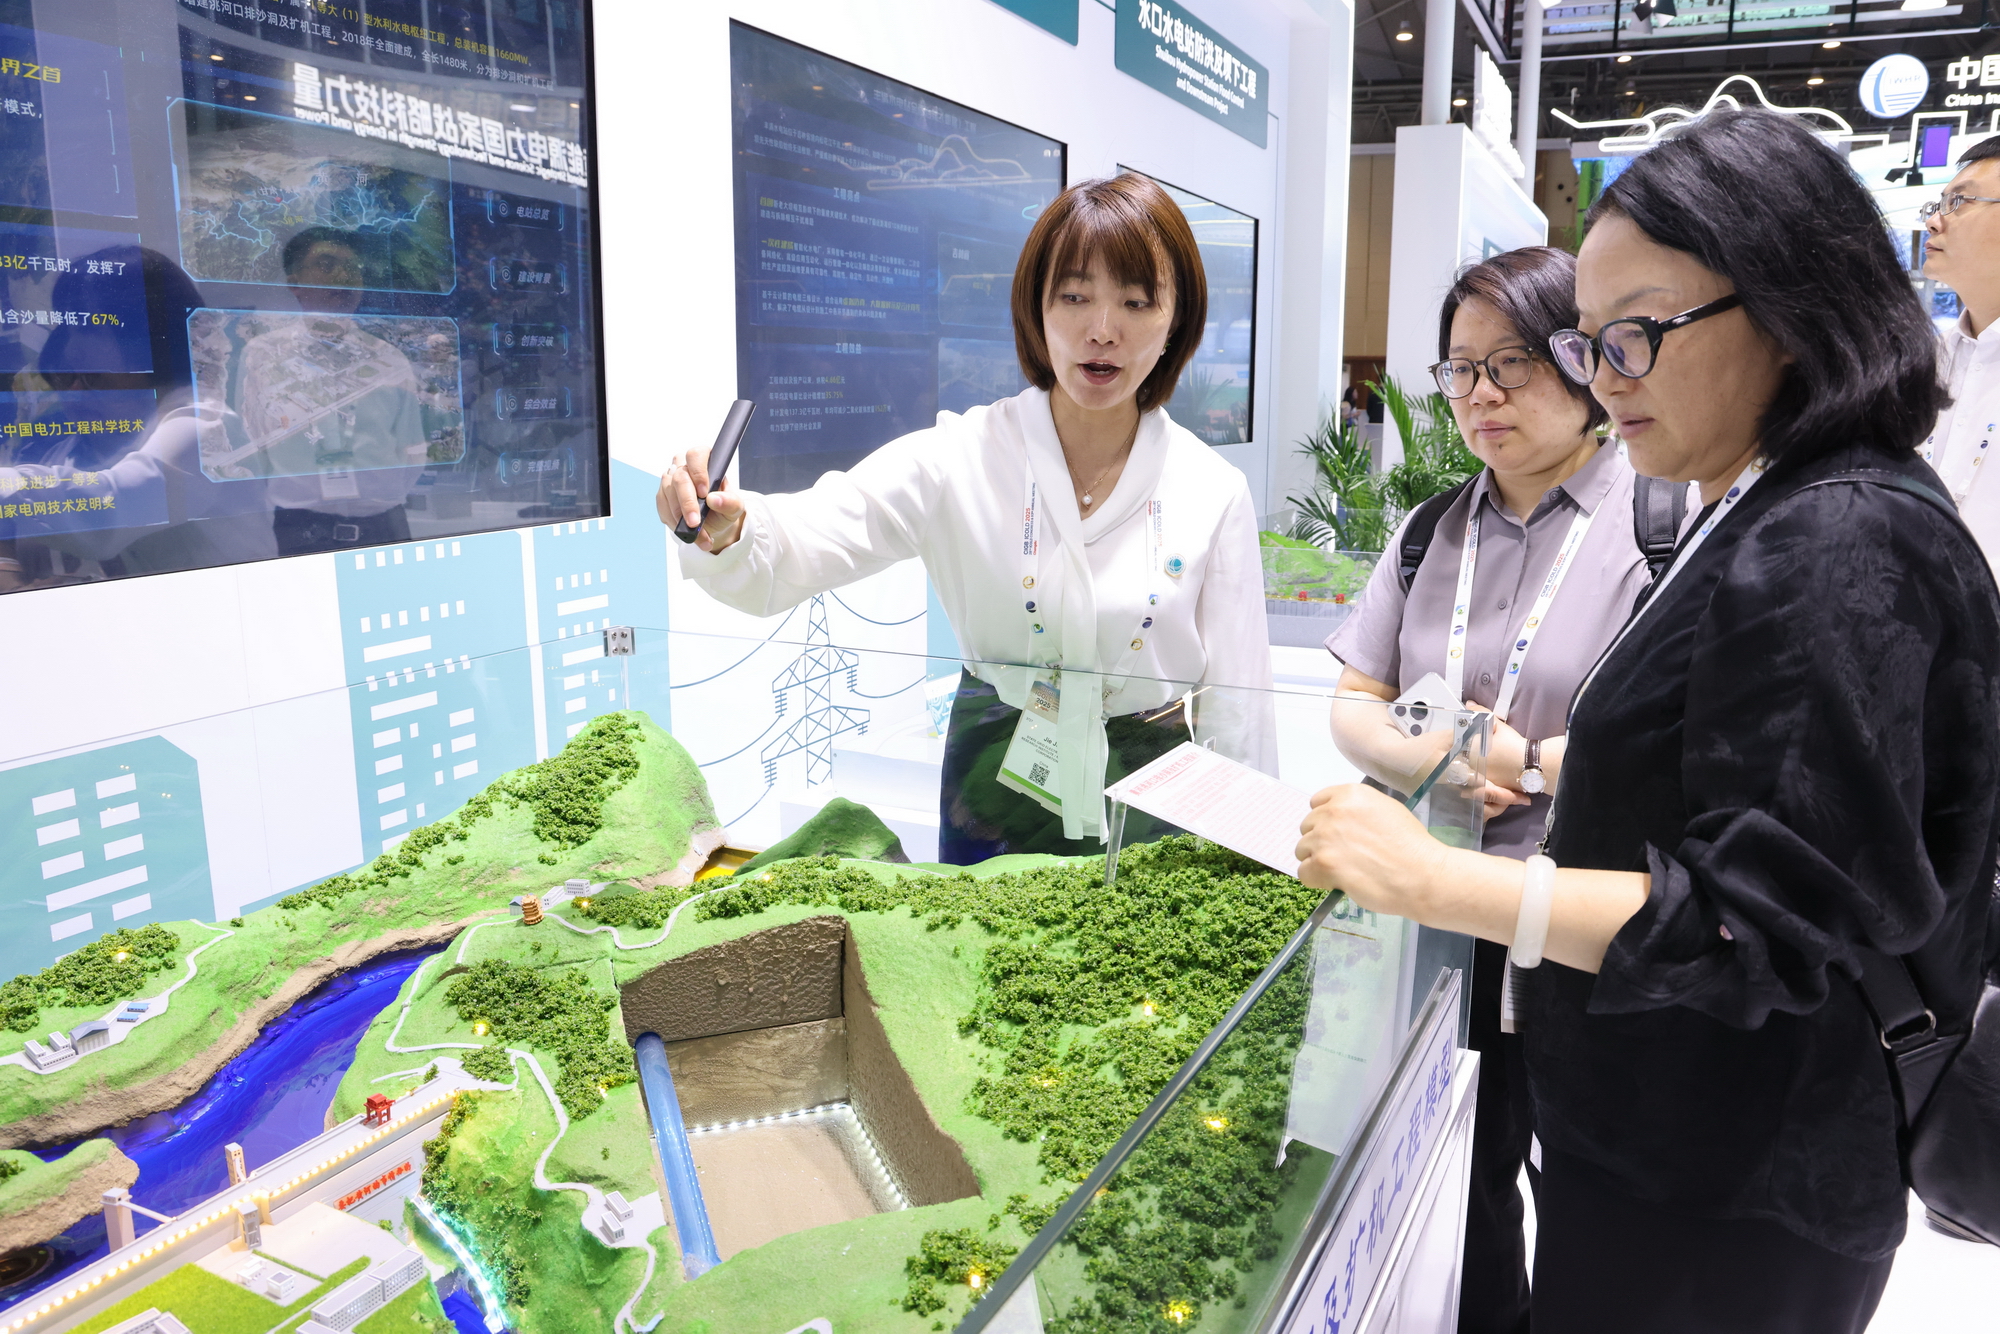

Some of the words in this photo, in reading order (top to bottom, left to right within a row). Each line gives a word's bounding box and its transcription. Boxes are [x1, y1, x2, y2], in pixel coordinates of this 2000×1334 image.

[1155, 44, 1176, 67] Shuikou
[1175, 57, 1205, 84] Hydropower
[1203, 74, 1219, 92] Station
[1218, 83, 1231, 101] Flood
[1230, 91, 1245, 109] Control
[1176, 77, 1187, 91] and
[1186, 80, 1214, 107] Downstream
[1213, 97, 1229, 115] Project
[0, 419, 145, 438] 中国电力工程科学技术
[0, 495, 116, 519] 家电网技术发明奖
[1555, 553, 1565, 566] 2025
[1036, 697, 1051, 709] 2025
[1302, 1036, 1453, 1334] 及扩机工程模型
